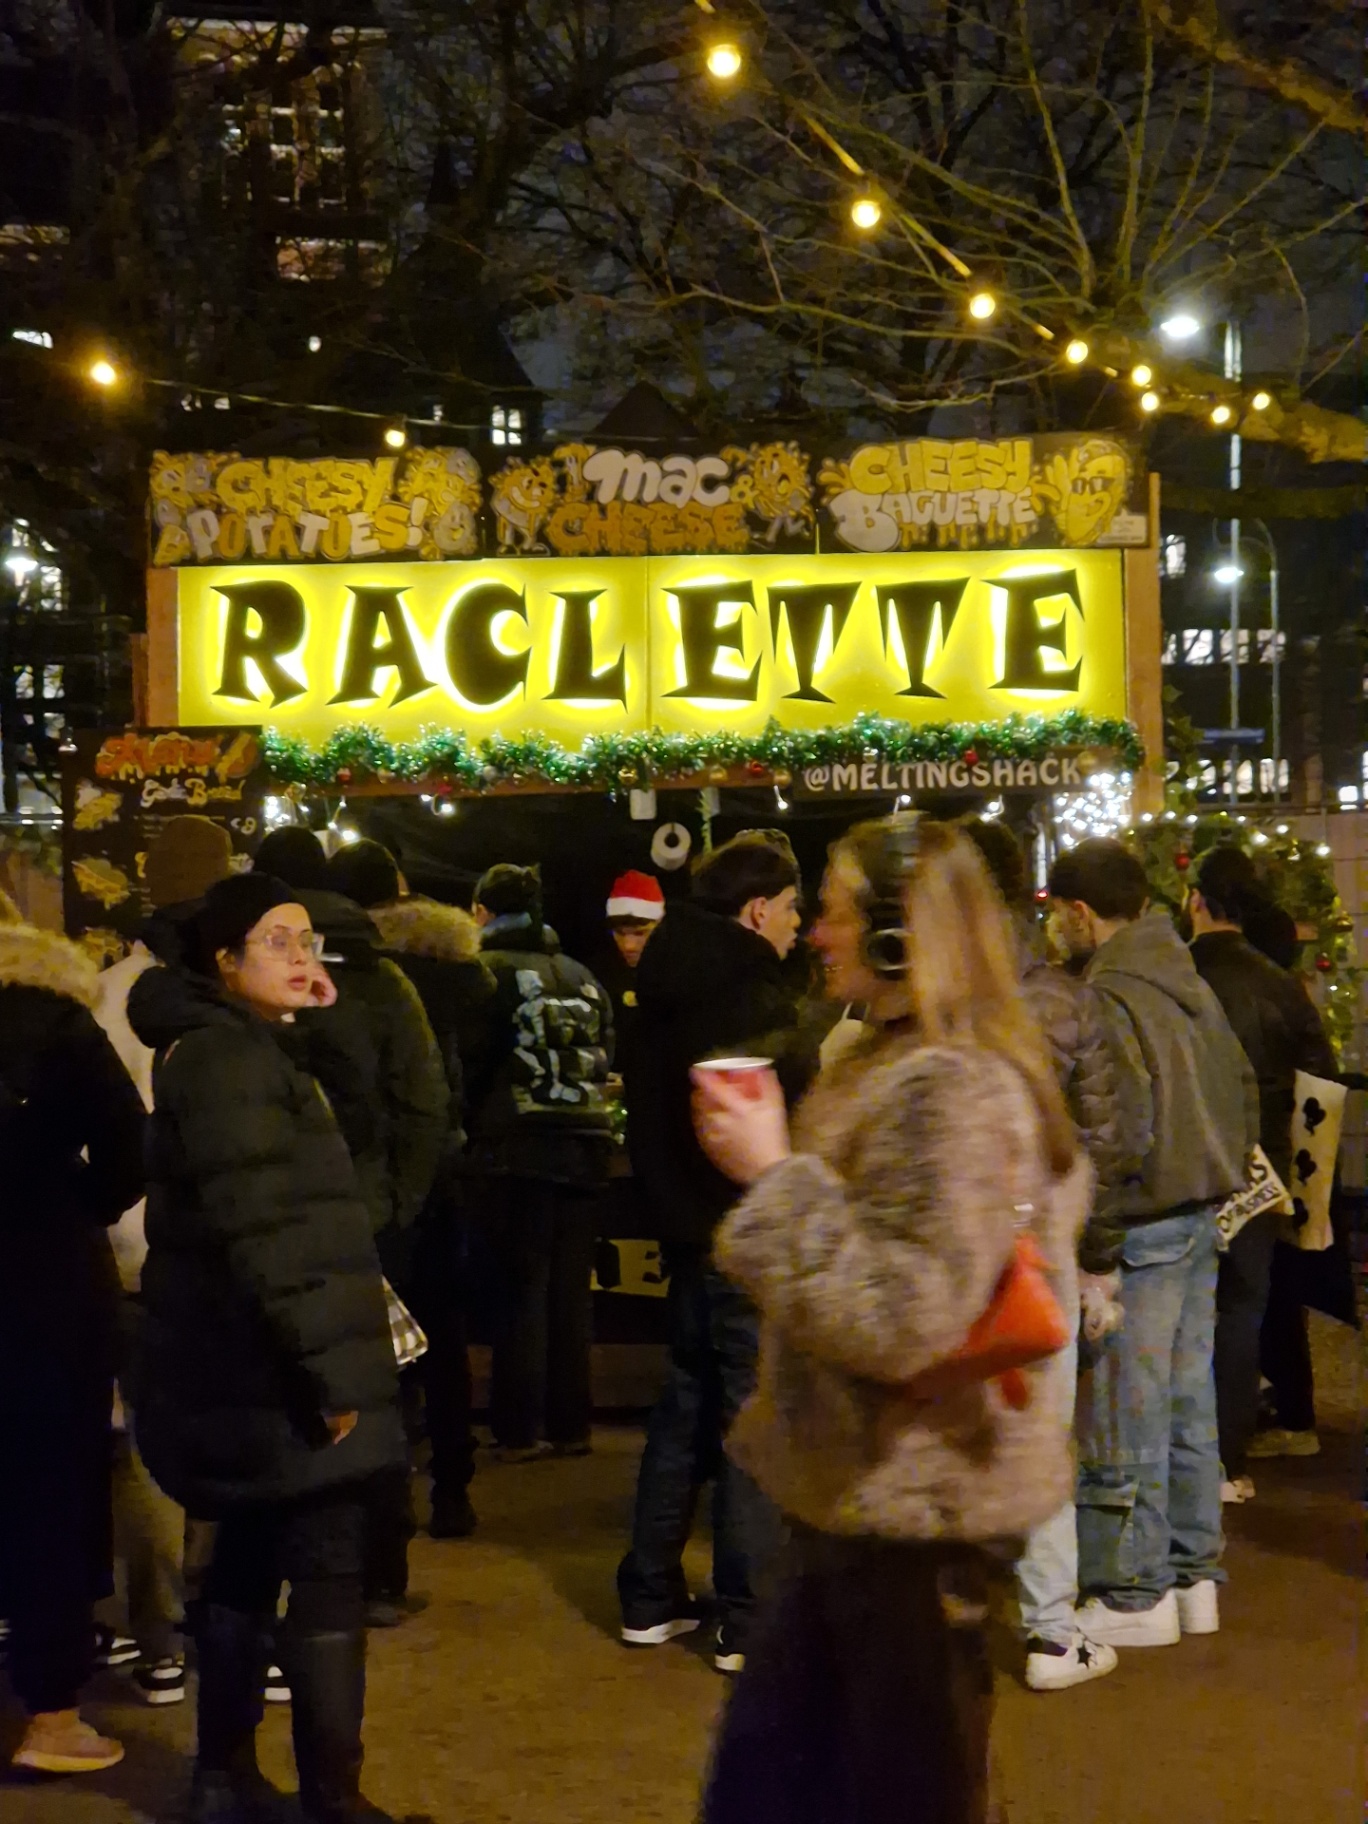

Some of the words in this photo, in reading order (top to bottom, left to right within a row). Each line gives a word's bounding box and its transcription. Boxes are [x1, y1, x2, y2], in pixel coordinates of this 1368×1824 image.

[216, 457, 398, 517] CHEESY
[850, 437, 1033, 494] CHEESY
[187, 497, 428, 560] POTATOES!
[548, 501, 749, 555] CHEESE
[829, 488, 1039, 552] BAGUETTE
[209, 569, 1085, 713] RACLETTE
[803, 758, 1082, 791] @MELTINGSHACK
